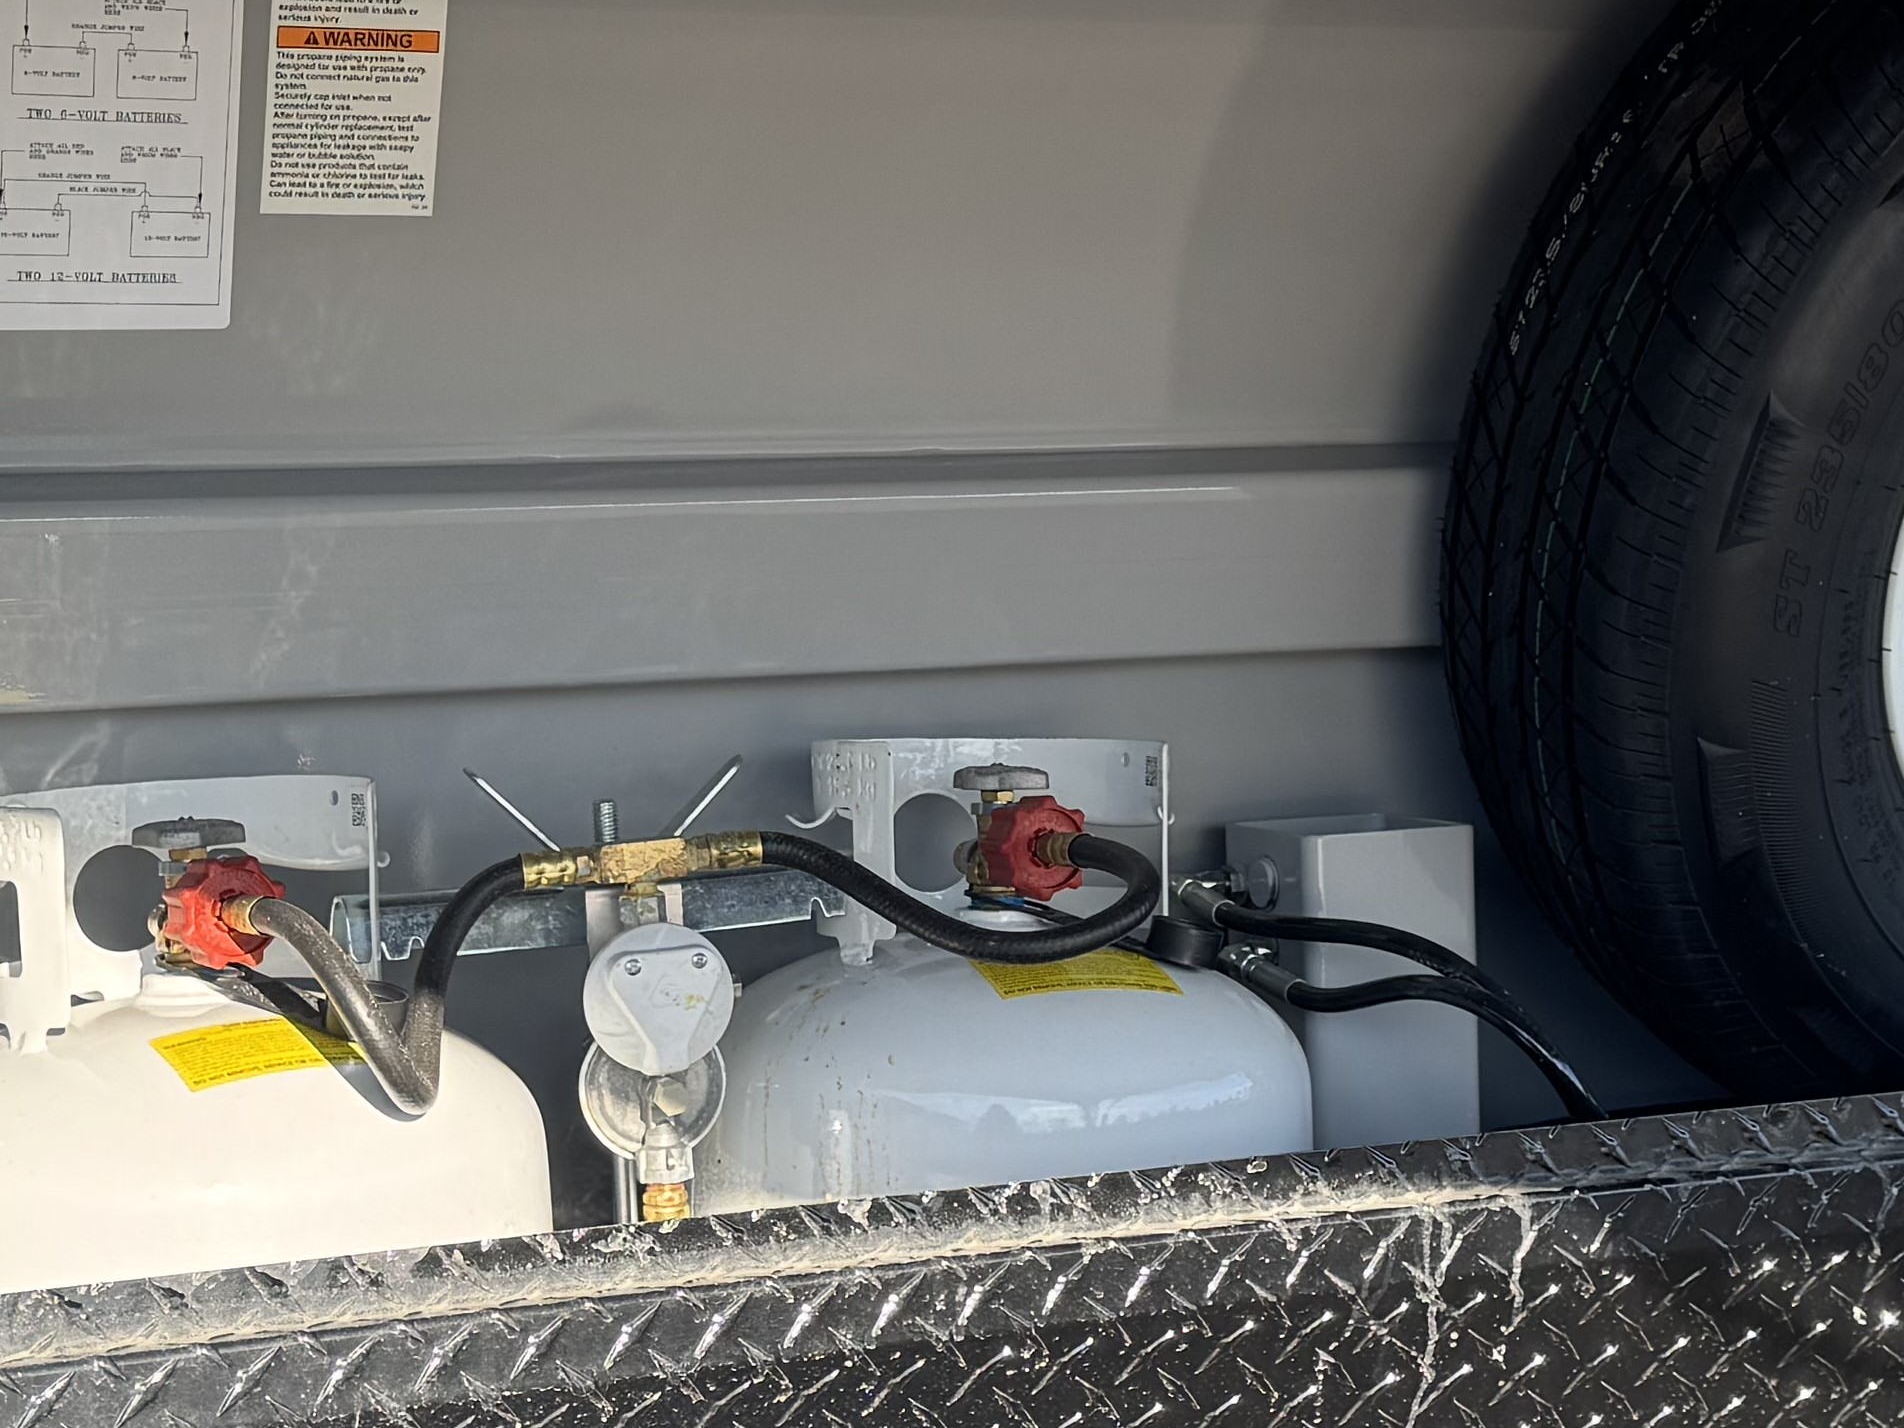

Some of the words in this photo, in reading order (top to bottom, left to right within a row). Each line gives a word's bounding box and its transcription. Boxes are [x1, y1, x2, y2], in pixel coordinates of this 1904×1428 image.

[325, 33, 413, 49] WARNING
[26, 108, 51, 120] TWO
[115, 111, 182, 123] BATTERIES
[16, 270, 41, 281] TWO
[51, 271, 103, 282] 12-VOLT
[111, 272, 177, 284] BATTERIES
